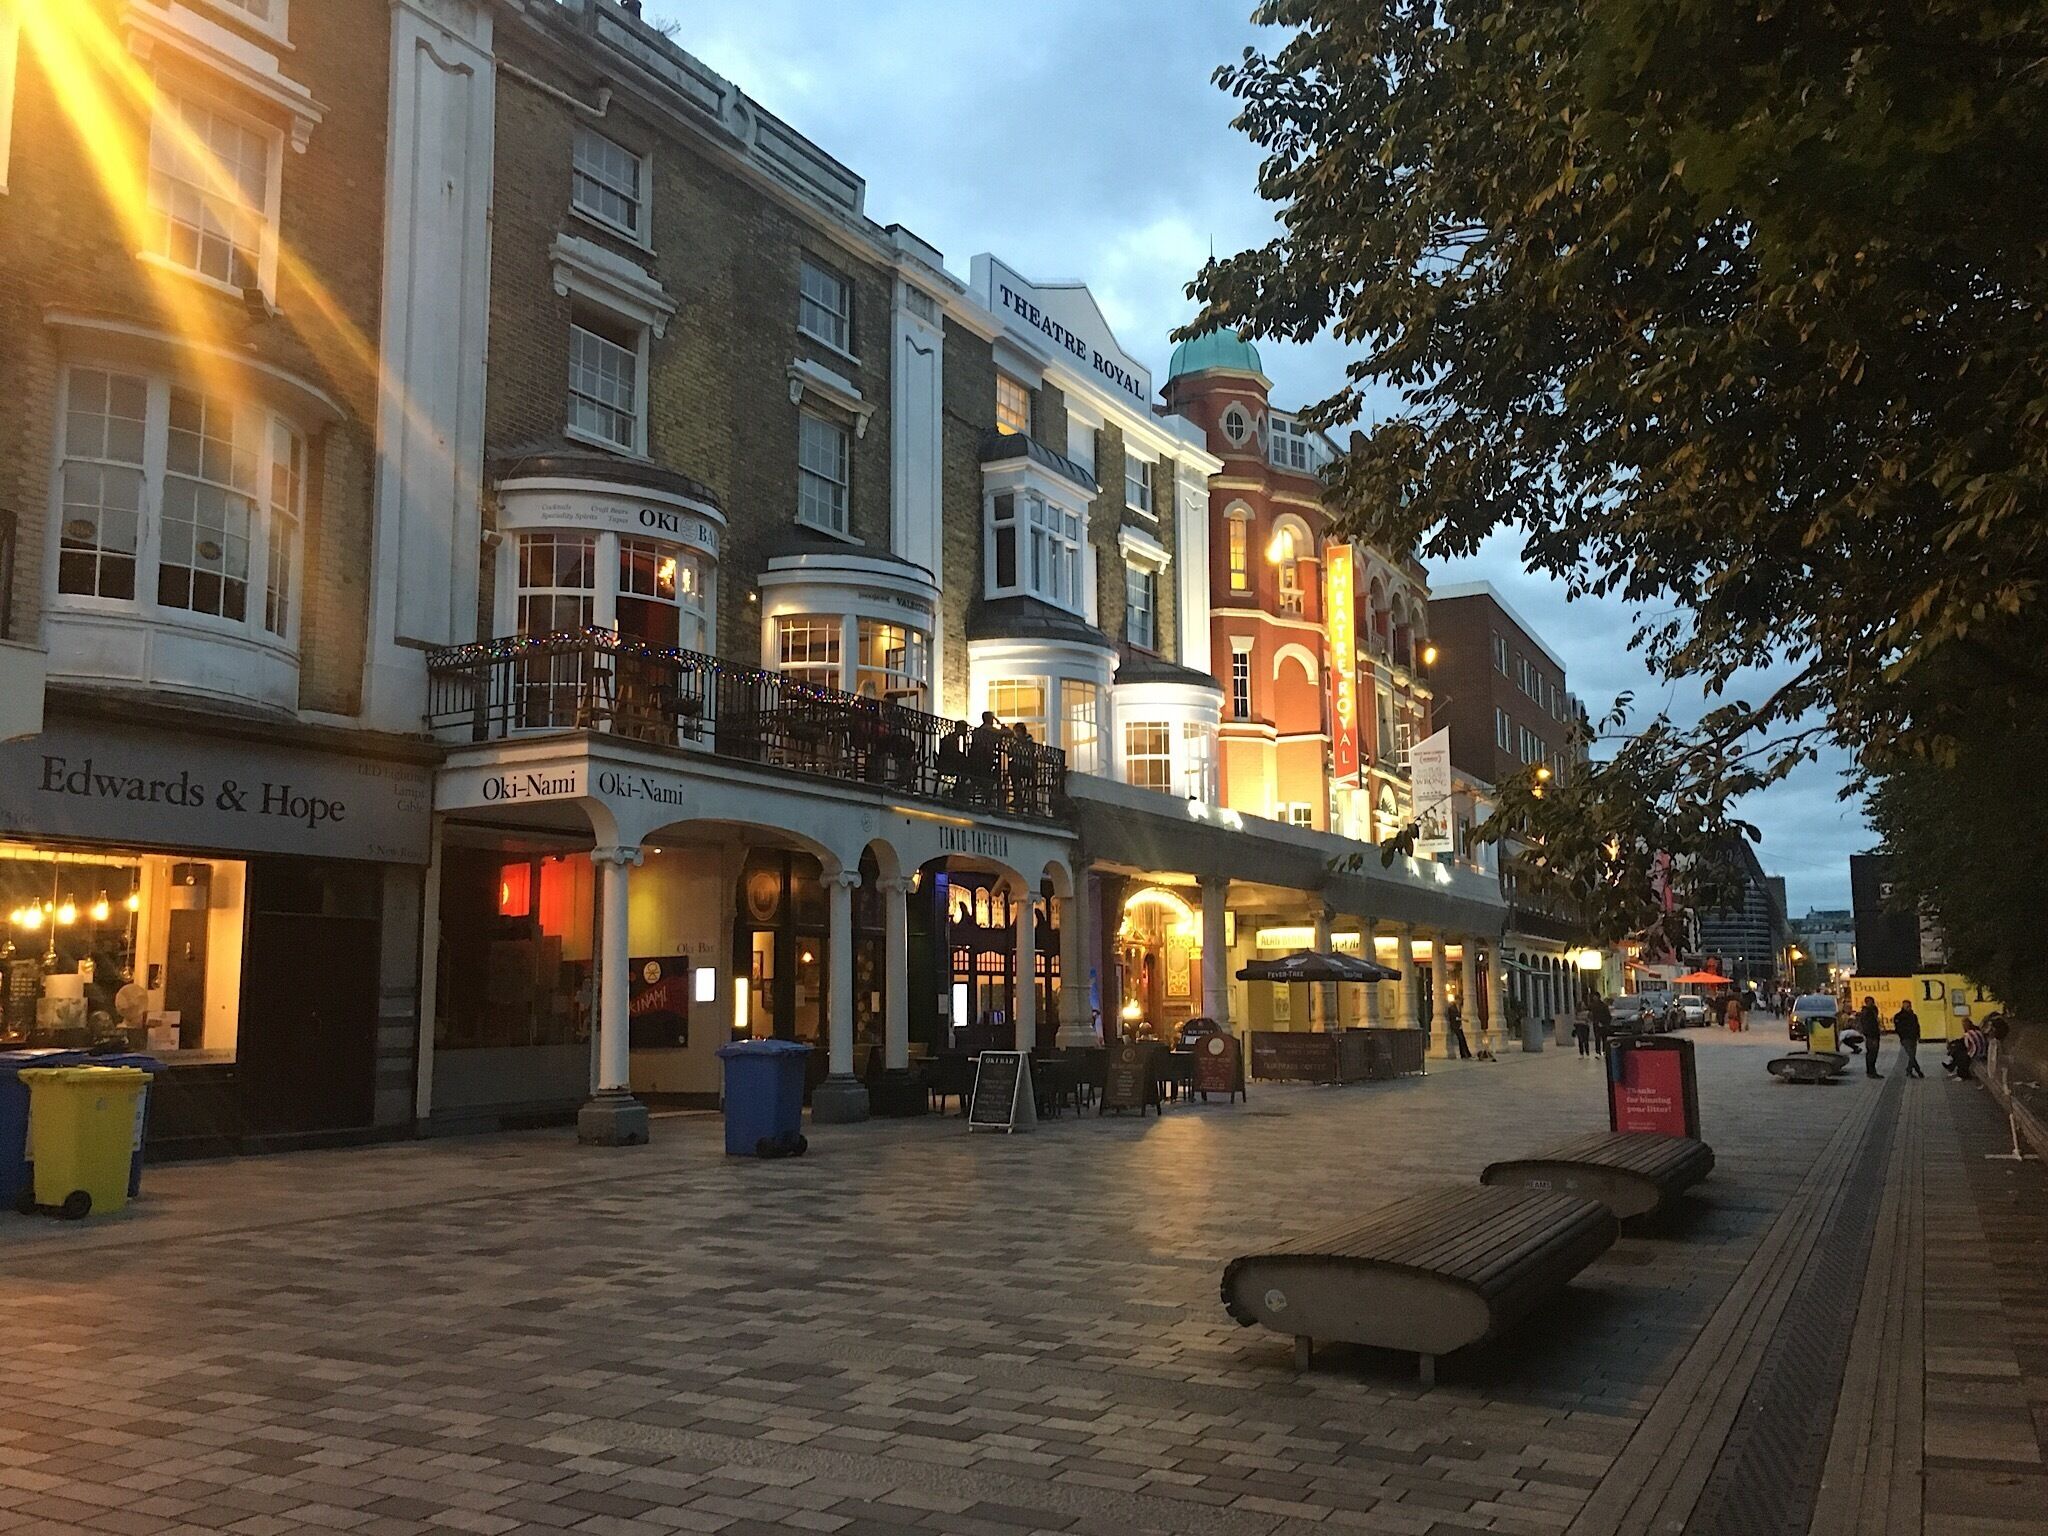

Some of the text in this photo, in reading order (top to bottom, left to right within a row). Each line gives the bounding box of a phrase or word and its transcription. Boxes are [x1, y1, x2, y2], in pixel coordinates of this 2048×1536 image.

[1000, 284, 1144, 401] THEATRE ROYAL
[639, 509, 678, 533] OKI
[1333, 557, 1351, 764] THEATRE ROYAL
[38, 754, 346, 829] Edwards & Hope
[482, 770, 575, 800] Oki-Nami
[600, 772, 683, 805] Oki-Nami
[1853, 981, 1890, 992] Build
[1921, 979, 1945, 1001] D
[1627, 1105, 1672, 1113] your litter!
[1640, 1096, 1671, 1104] binning
